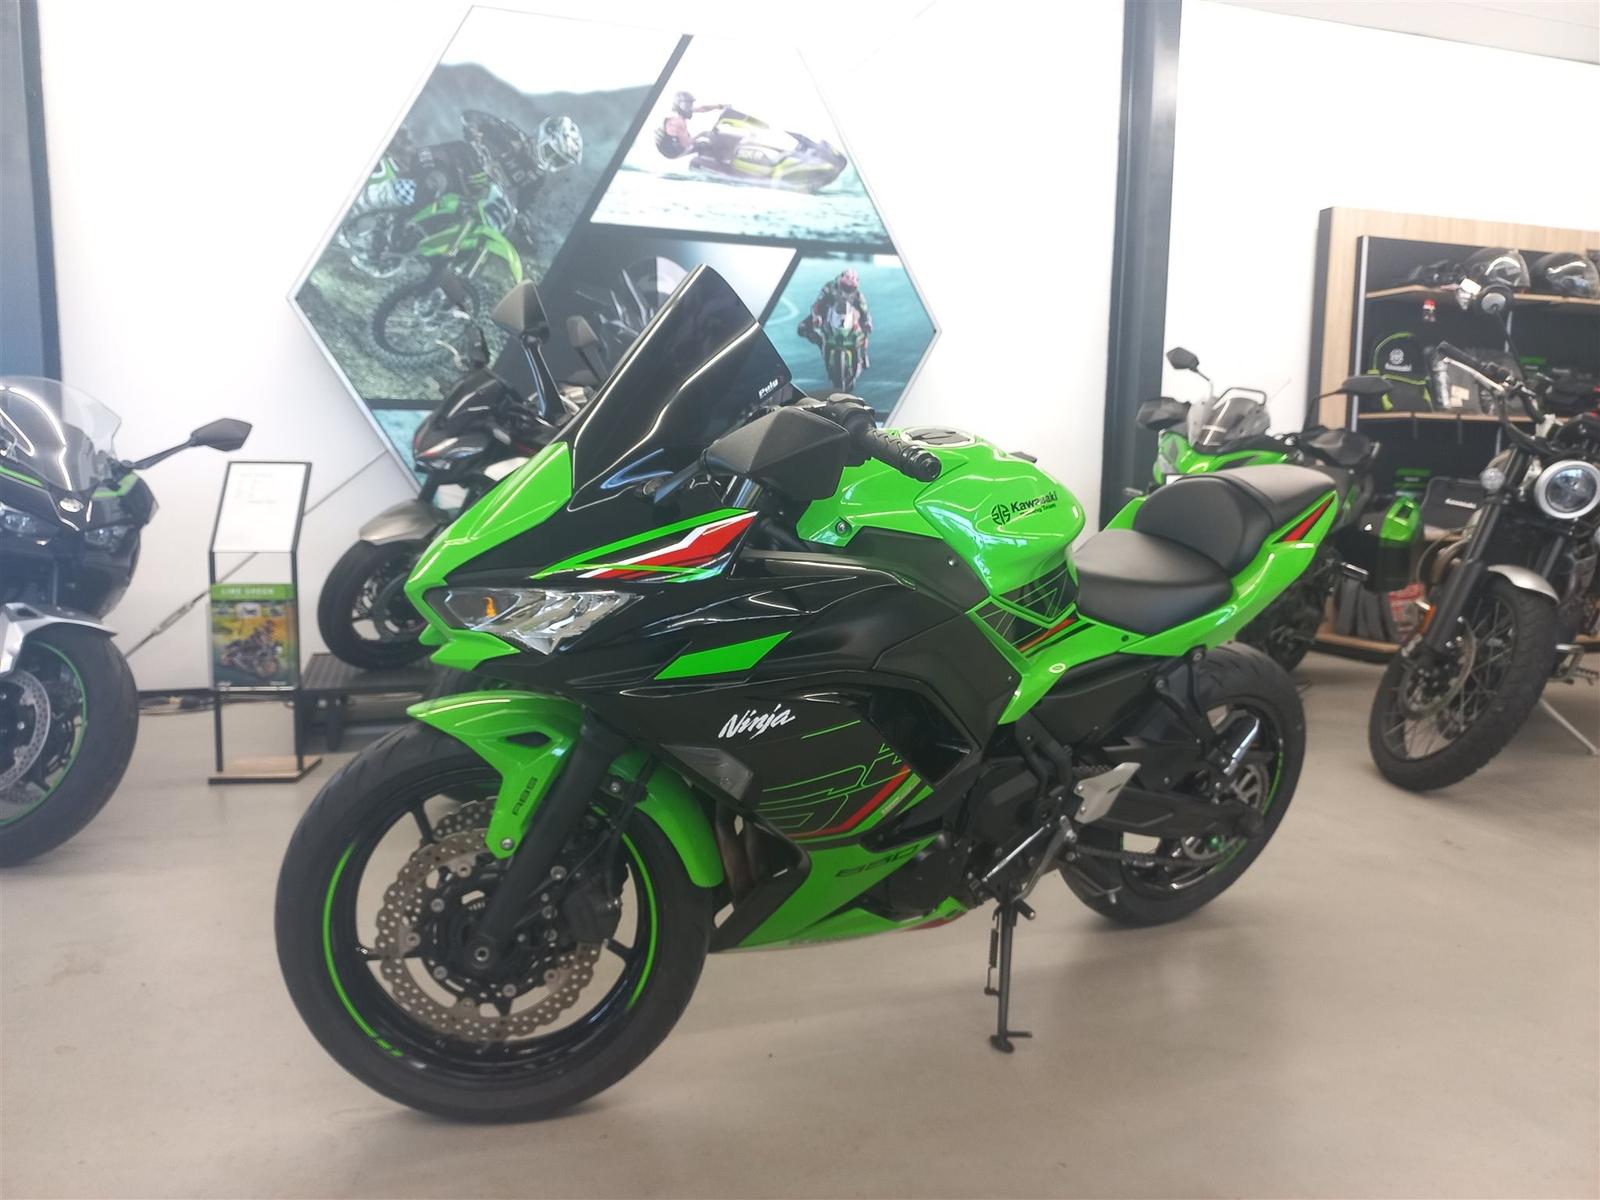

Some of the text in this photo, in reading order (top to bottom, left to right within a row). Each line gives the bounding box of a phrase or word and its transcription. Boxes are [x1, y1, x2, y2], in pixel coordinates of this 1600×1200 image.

[1010, 490, 1058, 513] Kawasaki
[718, 703, 796, 740] Ninja
[511, 775, 539, 817] ABS
